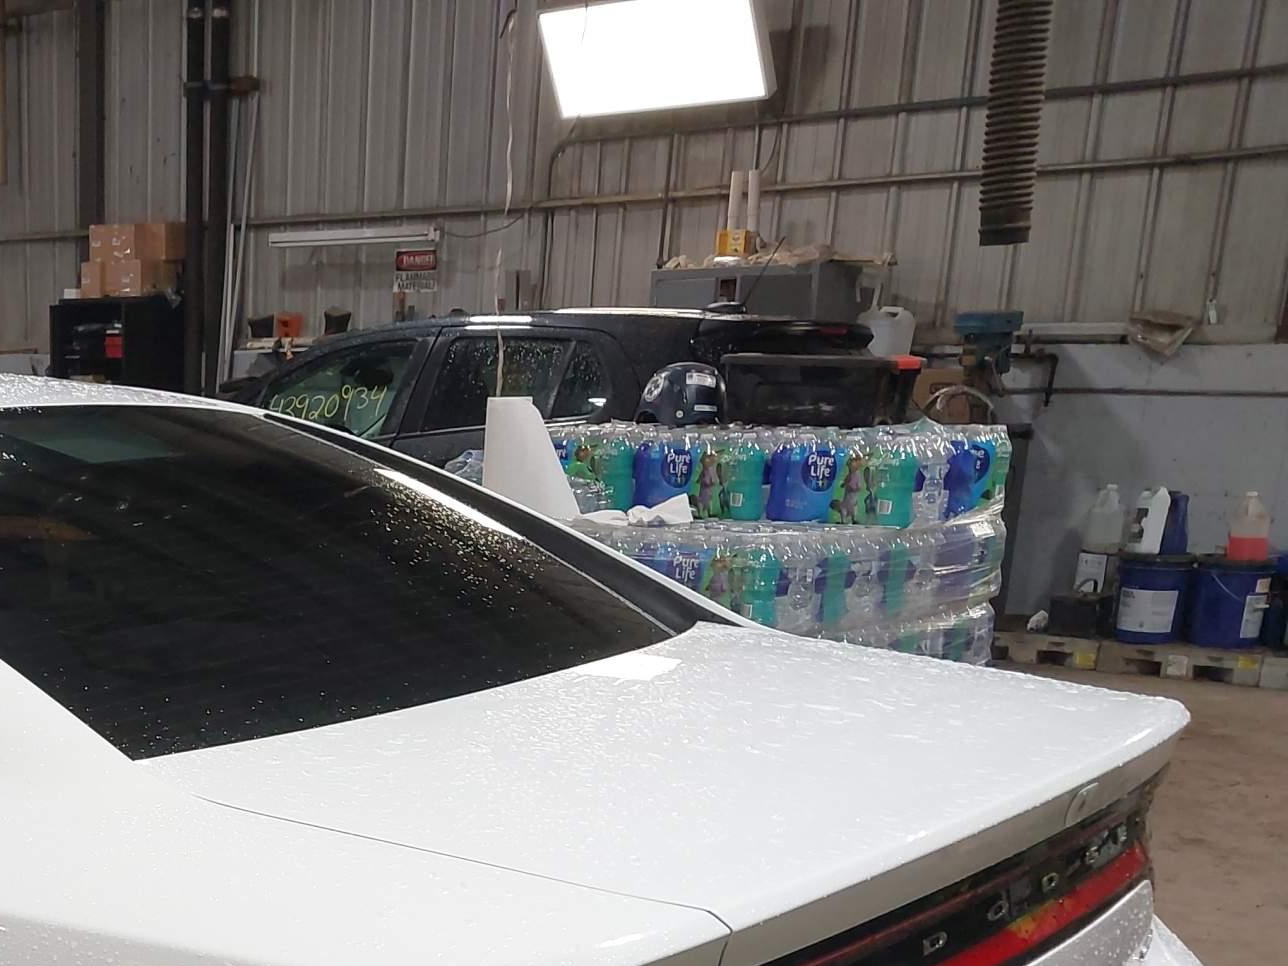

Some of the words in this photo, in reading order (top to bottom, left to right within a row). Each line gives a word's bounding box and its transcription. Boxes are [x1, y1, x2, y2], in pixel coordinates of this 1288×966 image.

[269, 384, 388, 420] 43920934
[667, 451, 691, 464] Pure
[808, 453, 834, 466] Pure
[669, 460, 688, 476] Life
[810, 463, 831, 479] Life
